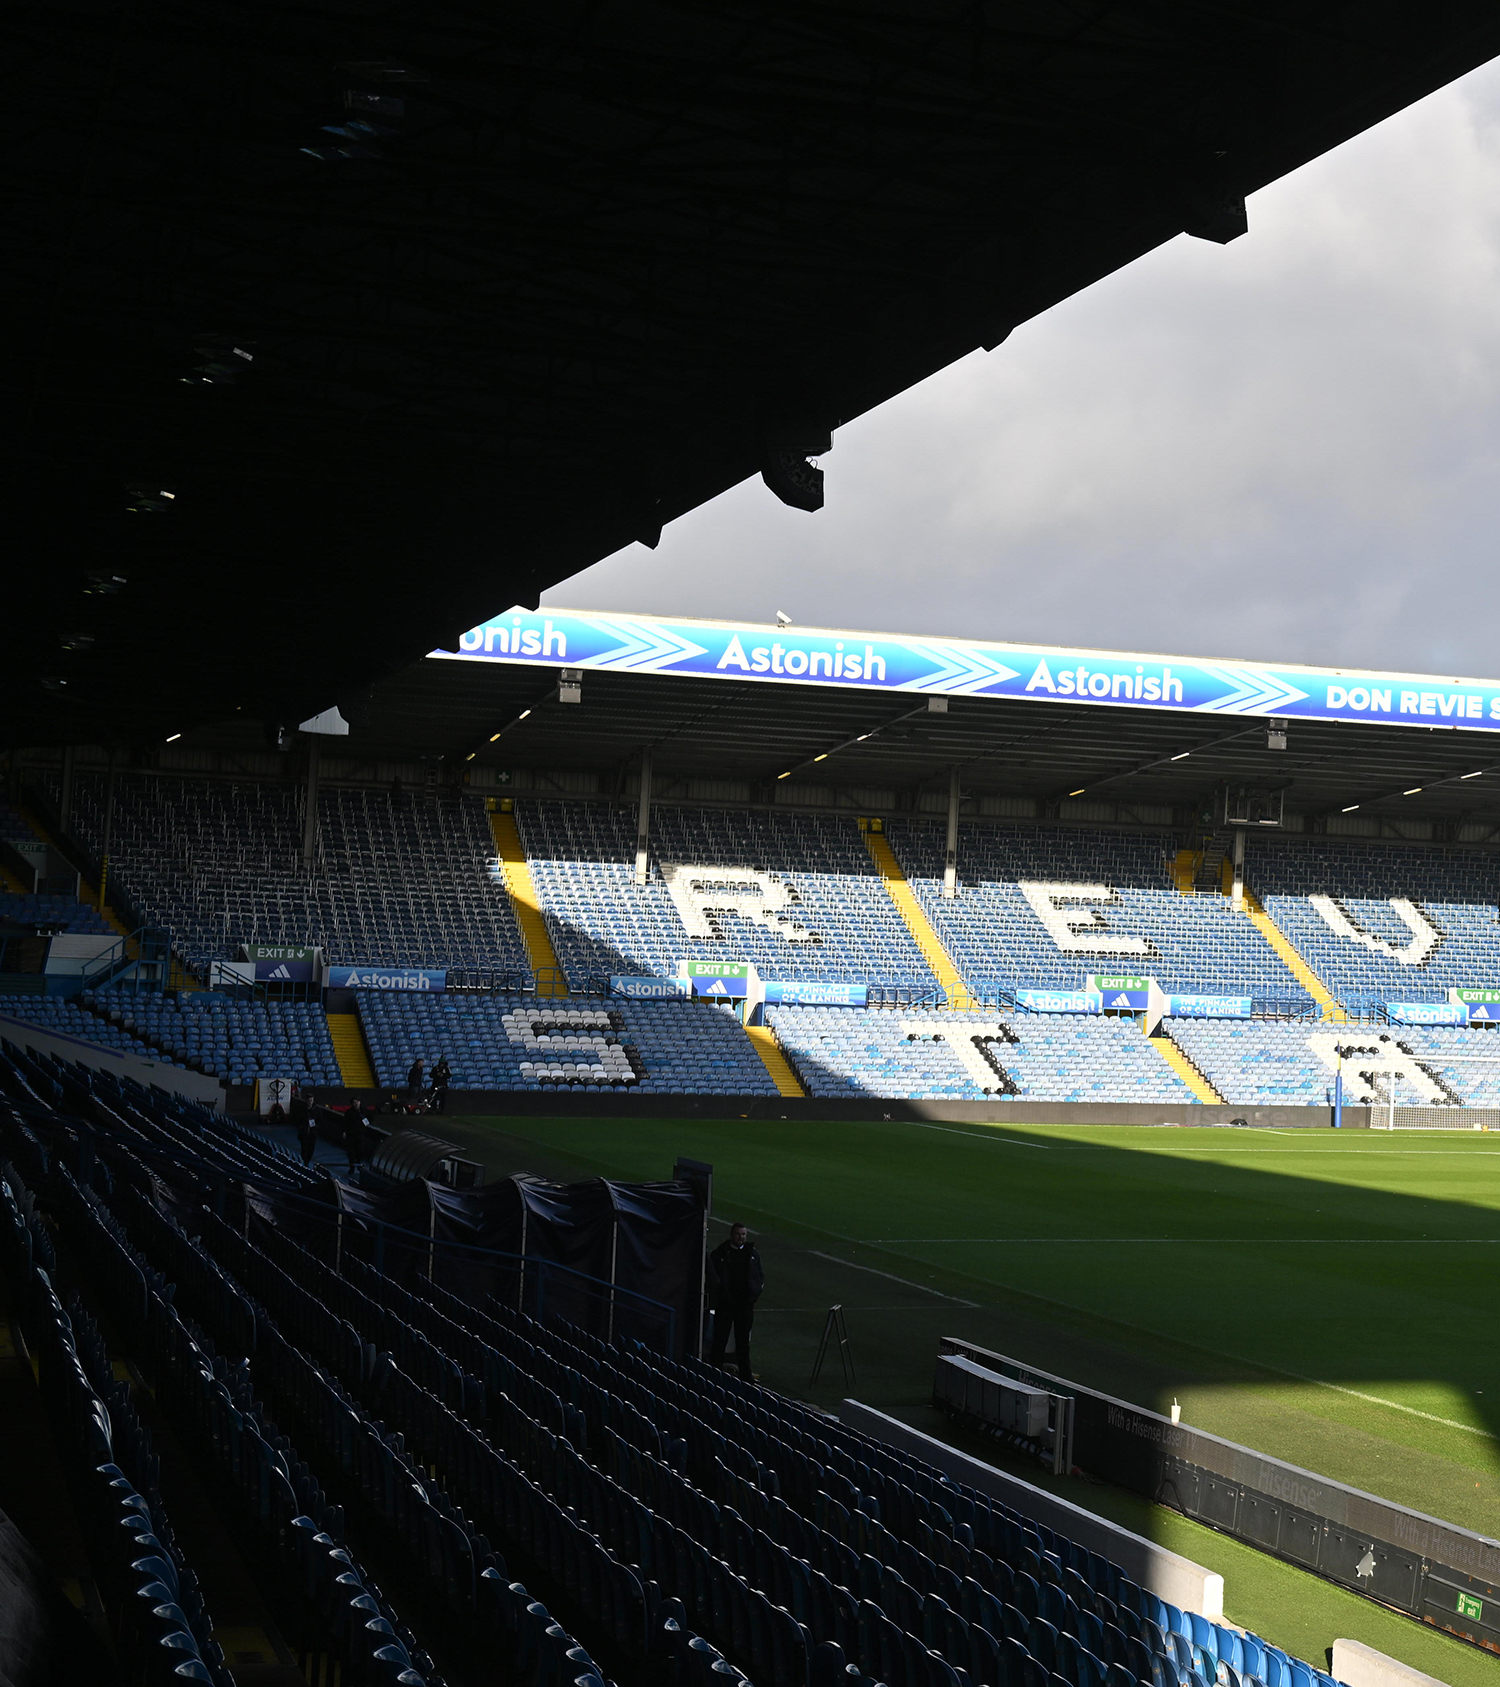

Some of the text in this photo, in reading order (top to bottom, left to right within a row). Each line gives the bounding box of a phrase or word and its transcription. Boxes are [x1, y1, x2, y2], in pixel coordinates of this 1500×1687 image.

[459, 617, 567, 657] onish
[717, 633, 886, 682] Astonish
[1024, 657, 1183, 702] Astonish
[1326, 685, 1394, 713] DON
[1399, 690, 1483, 719] REVIE
[17, 843, 38, 851] EXIT
[257, 948, 285, 959] EXIT
[696, 964, 721, 975] EXIT
[345, 970, 430, 989] Astonish
[615, 979, 685, 997] Astonish
[1102, 979, 1125, 989] EXIT
[782, 984, 850, 995] THE PINNACLE
[1463, 992, 1484, 1001] EXIT
[781, 994, 849, 1003] OF CLEANING
[1023, 992, 1095, 1011] Astonish
[1180, 998, 1242, 1007] THE PINNACLE
[1179, 1006, 1241, 1015] OF CLEANING
[1395, 1006, 1461, 1023] Astonish
[1107, 1405, 1198, 1450] With a Hisense Laser TV
[1258, 1462, 1315, 1507] Hisense
[1394, 1515, 1418, 1545] With
[1432, 1530, 1477, 1568] Hisense
